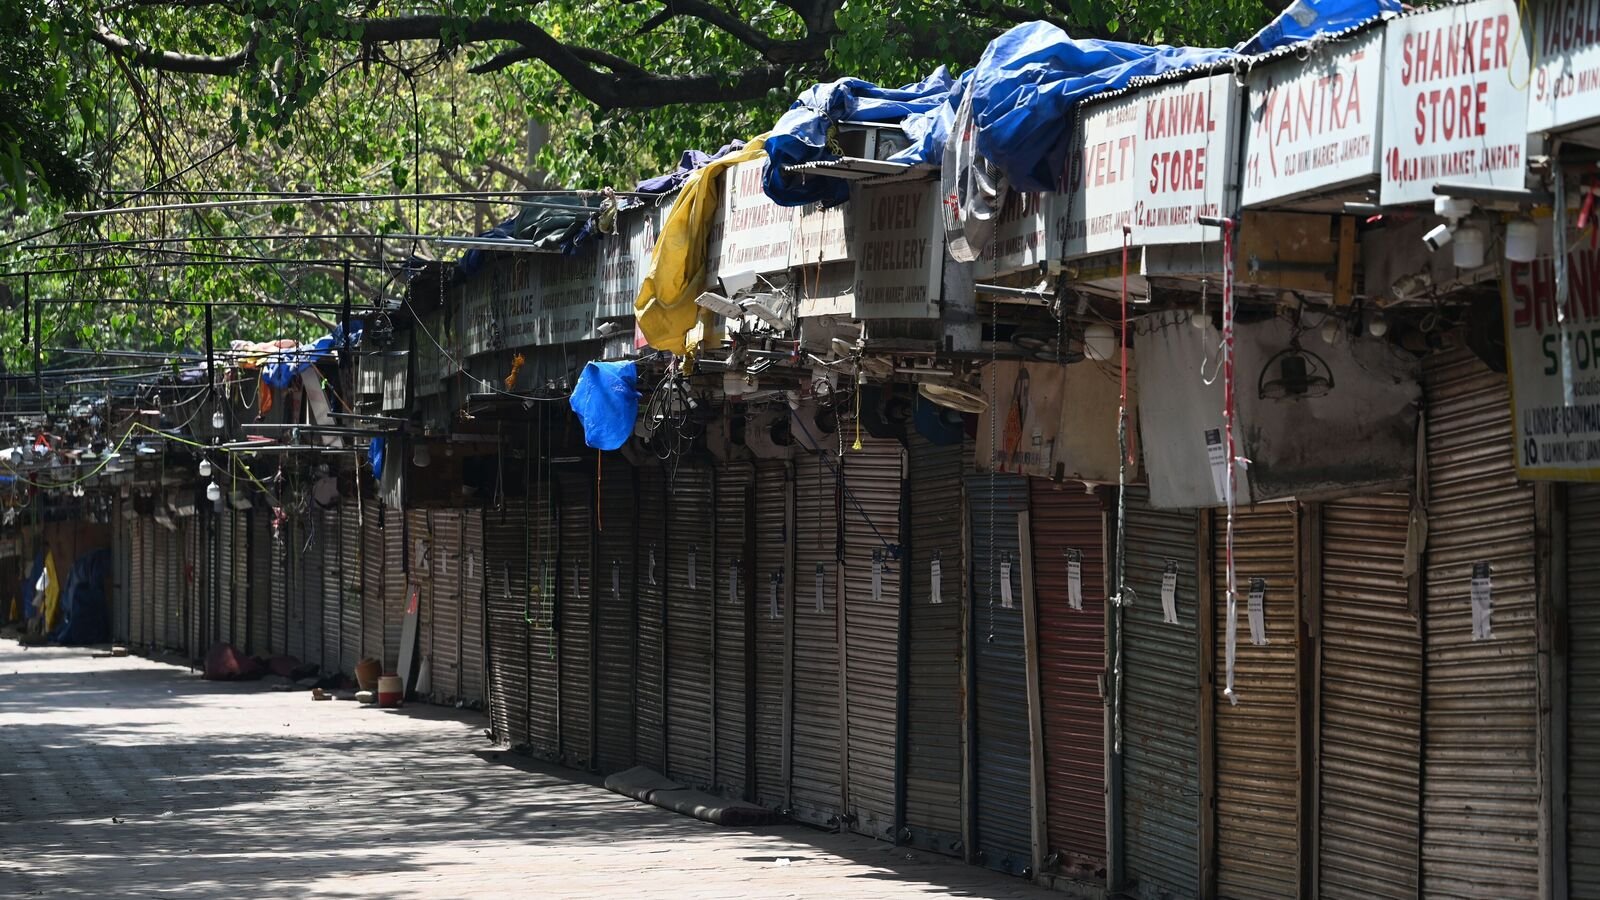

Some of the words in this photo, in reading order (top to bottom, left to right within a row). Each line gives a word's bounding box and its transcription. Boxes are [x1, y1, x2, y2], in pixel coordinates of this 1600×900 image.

[1401, 14, 1510, 86] SHANKER
[1145, 91, 1215, 140] KANWAL
[1415, 82, 1488, 146] STORE
[1150, 147, 1205, 194] STORE
[1284, 154, 1296, 177] OLD
[1340, 134, 1371, 162] JANPATH
[1403, 157, 1419, 182] OLD
[1420, 154, 1439, 180] MINI
[1480, 144, 1520, 172] JANPATH
[731, 203, 771, 232] READYMADE
[870, 193, 922, 232] LOVELY
[1157, 206, 1169, 227] MINI
[860, 238, 927, 272] JEWELLERY
[1511, 248, 1600, 334] SHNK
[1542, 329, 1600, 376] SO
